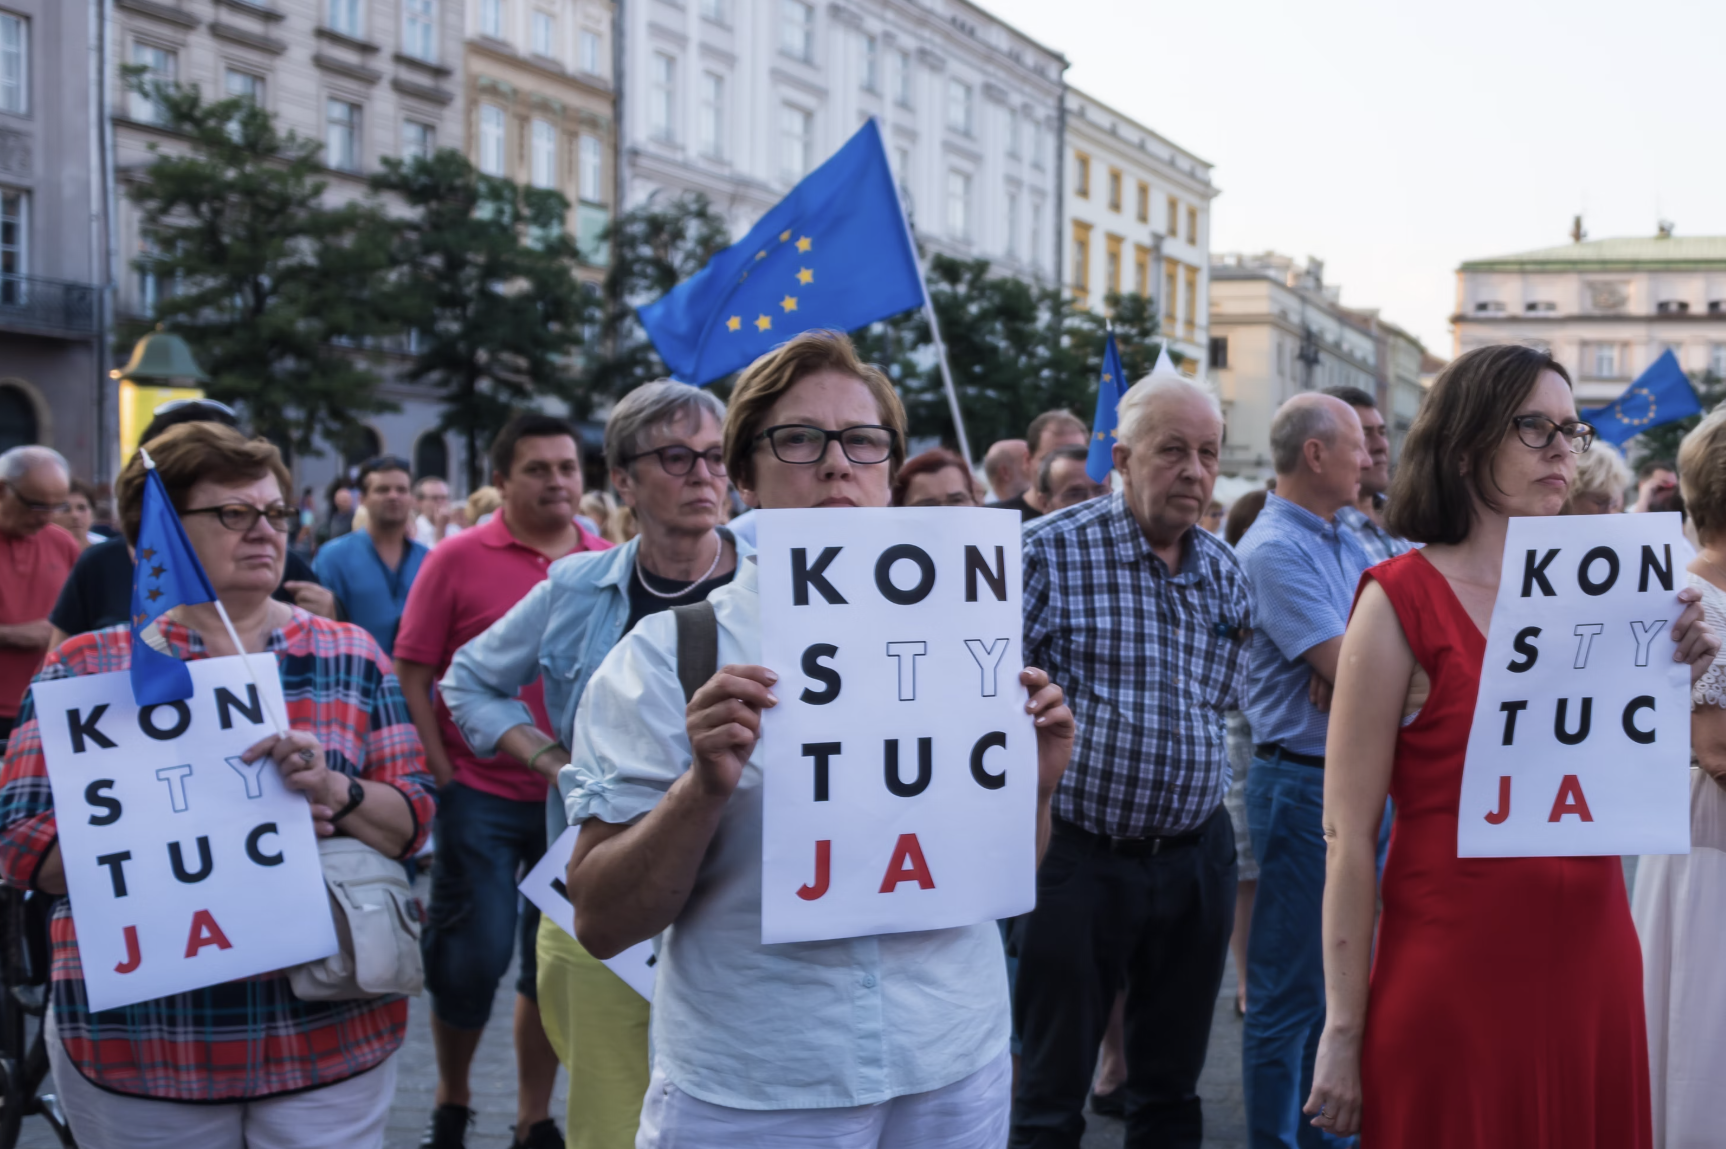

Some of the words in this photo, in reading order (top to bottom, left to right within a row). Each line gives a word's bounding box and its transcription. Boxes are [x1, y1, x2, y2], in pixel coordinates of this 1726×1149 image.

[790, 543, 1008, 606] KON
[1520, 543, 1674, 598] KON
[799, 637, 1010, 706] STY
[1506, 619, 1668, 673] STY
[66, 683, 264, 754] KON
[1499, 695, 1656, 746] TUC
[84, 755, 268, 826] STY
[801, 731, 1008, 802] TUC
[1483, 774, 1595, 825] JA
[97, 822, 285, 898] TUC
[795, 833, 936, 901] JA
[113, 909, 232, 974] JA
